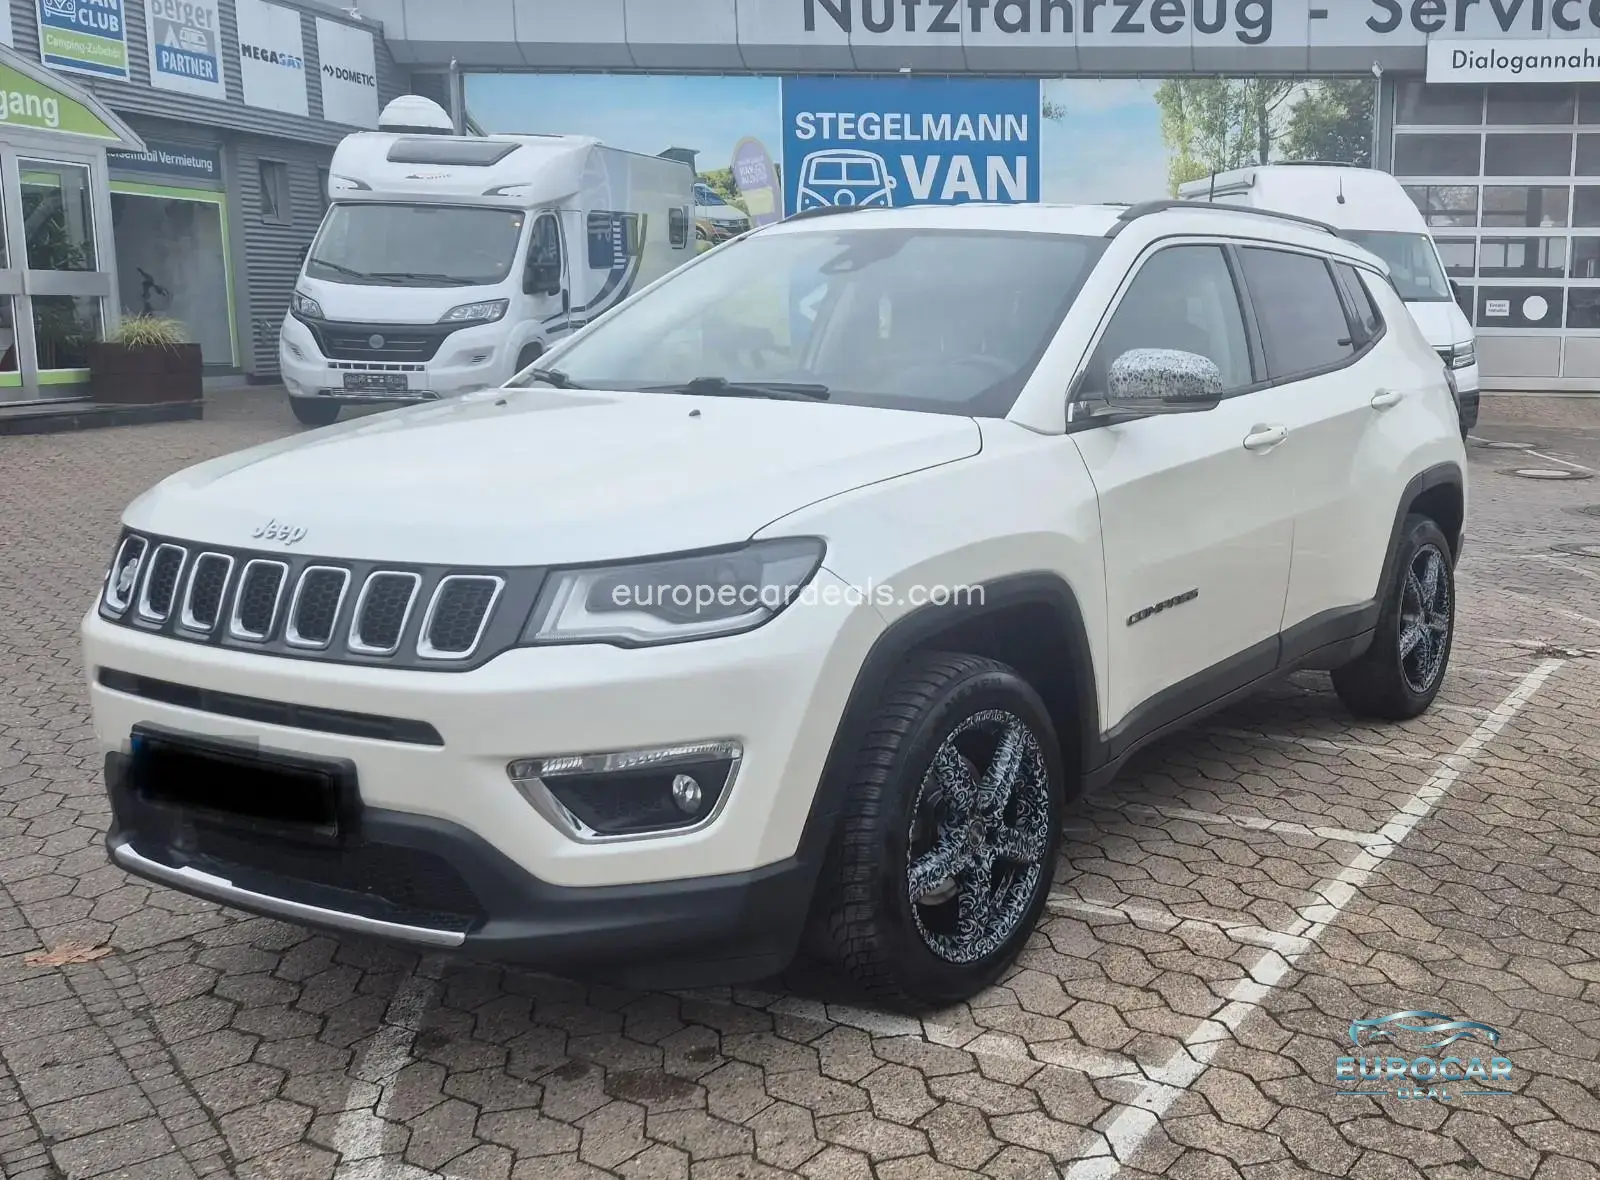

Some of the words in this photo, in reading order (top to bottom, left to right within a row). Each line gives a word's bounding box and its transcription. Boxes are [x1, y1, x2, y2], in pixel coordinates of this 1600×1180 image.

[78, 8, 119, 32] CLUB
[803, 0, 1272, 45] Nutzfahrzeug
[161, 50, 214, 79] PARTNER
[1452, 48, 1600, 74] Dialogannah
[335, 66, 376, 87] DOMETIC
[795, 111, 1028, 142] STEGELMANN
[159, 151, 214, 172] Vermietung
[900, 154, 1028, 201] VAN
[251, 518, 309, 546] Jeep
